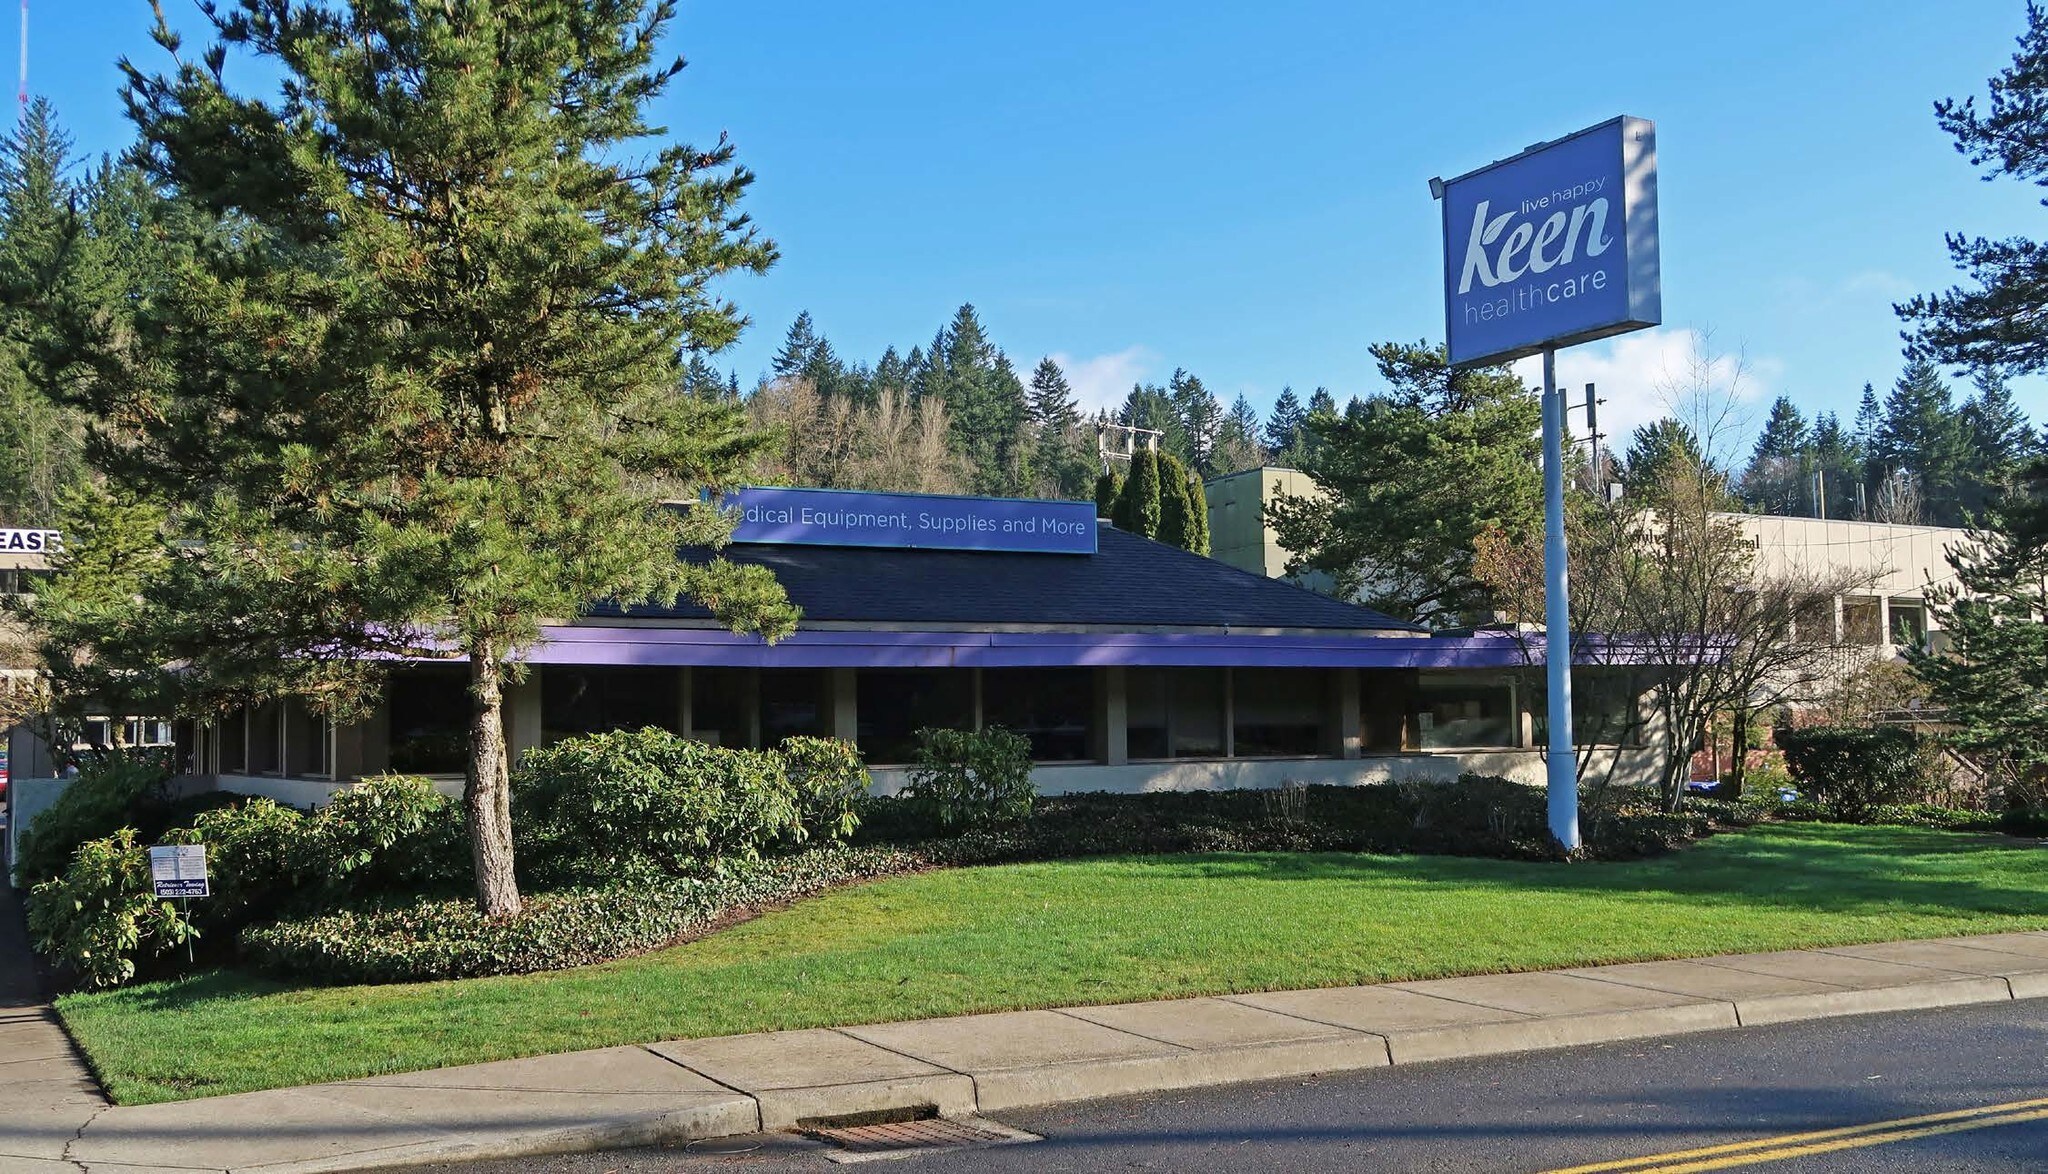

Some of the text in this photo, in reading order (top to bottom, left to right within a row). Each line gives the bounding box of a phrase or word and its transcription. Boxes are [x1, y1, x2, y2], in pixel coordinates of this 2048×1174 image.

[1521, 175, 1606, 215] live happy
[1464, 269, 1607, 326] healthcare
[801, 507, 913, 532] Equipment,
[918, 513, 998, 533] Supplies
[1002, 516, 1036, 535] and
[1042, 517, 1086, 536] More
